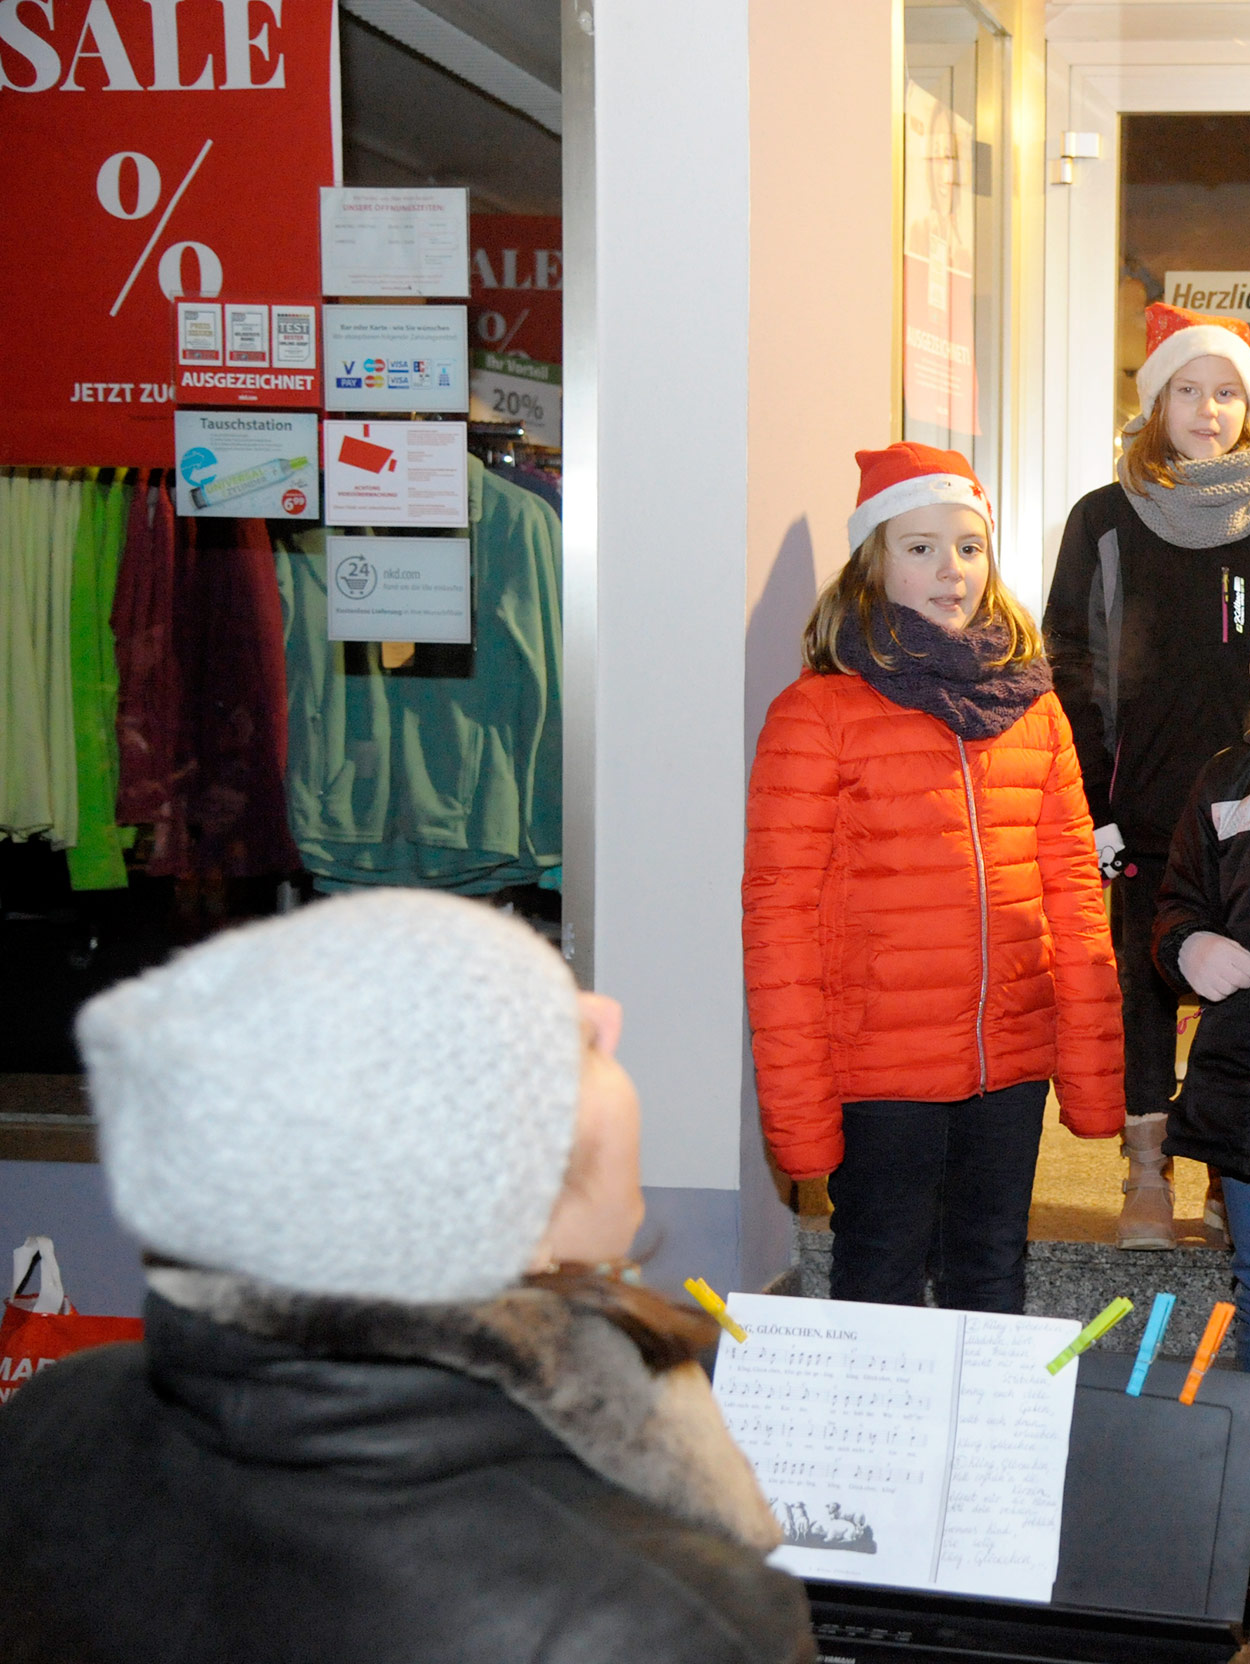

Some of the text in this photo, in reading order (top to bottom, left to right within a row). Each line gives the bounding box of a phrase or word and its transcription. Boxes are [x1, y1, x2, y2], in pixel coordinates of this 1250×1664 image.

[0, 0, 286, 92] SALE
[279, 322, 309, 334] TEST
[181, 371, 315, 391] AUSGEZEICHNET
[70, 382, 135, 403] JETZT
[492, 388, 544, 420] 20%
[200, 418, 292, 431] Tauschstation
[349, 562, 370, 577] 24
[383, 568, 421, 580] nkd.com
[757, 1324, 823, 1339] GLÖCKCHEN,
[826, 1329, 858, 1341] KLING
